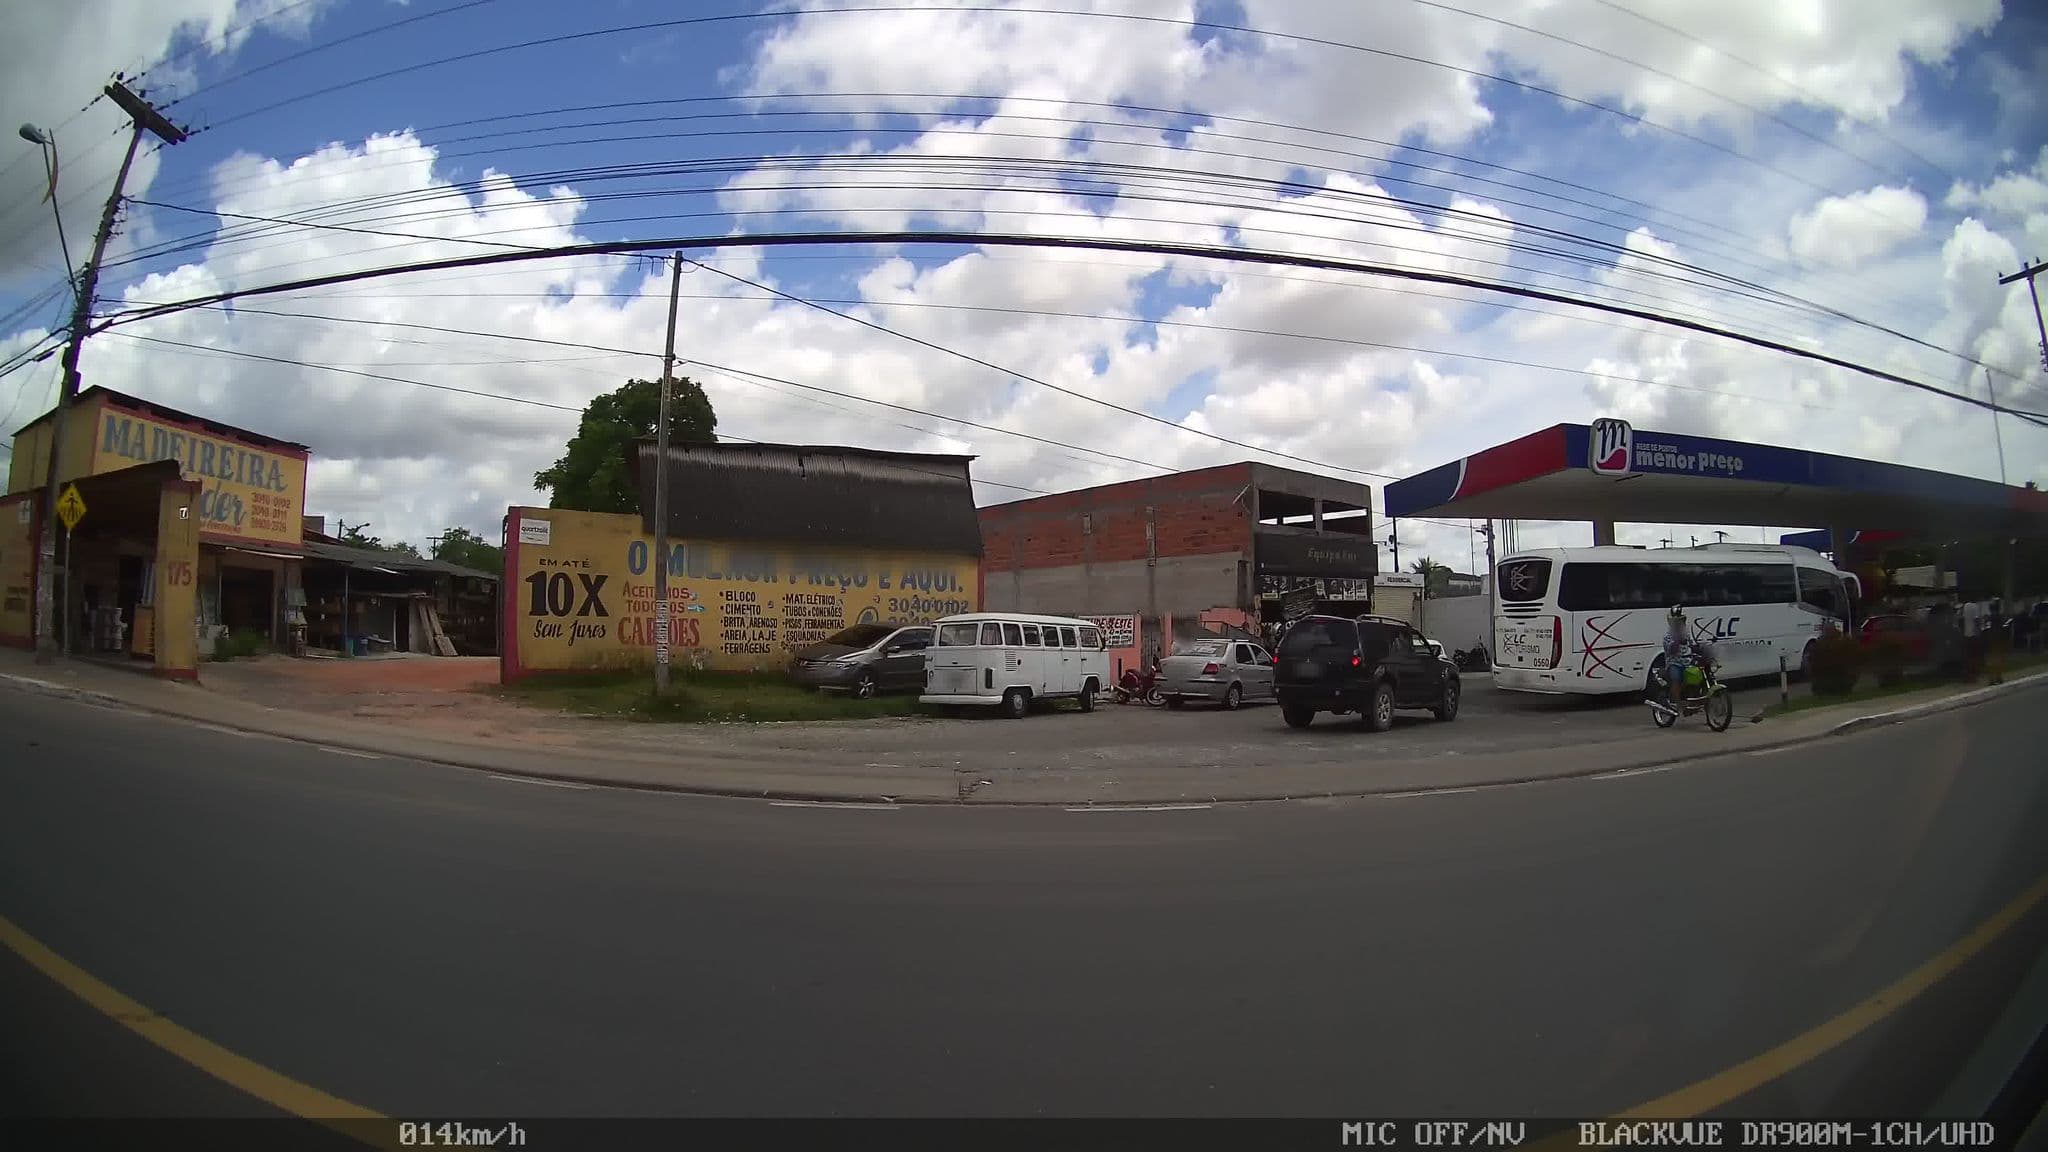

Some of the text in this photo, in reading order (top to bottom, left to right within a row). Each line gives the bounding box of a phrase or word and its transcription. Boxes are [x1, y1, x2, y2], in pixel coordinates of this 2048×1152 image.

[102, 415, 288, 492] MADEIREIRA
[1636, 451, 1744, 474] menor preço
[539, 558, 592, 568] EM ATÉ
[628, 540, 647, 575] O
[168, 561, 192, 586] 175
[525, 571, 609, 617] 10X
[622, 581, 690, 599] ACEITOS
[726, 591, 756, 602] BLOCO
[626, 600, 656, 613] TODO
[726, 604, 761, 615] CIMENTO
[784, 606, 806, 617] TUBOS
[805, 619, 845, 629] FERRAMENTAS
[618, 616, 700, 647] CARÕES
[752, 630, 777, 641] LAJE
[724, 643, 770, 654] FERRAGENS
